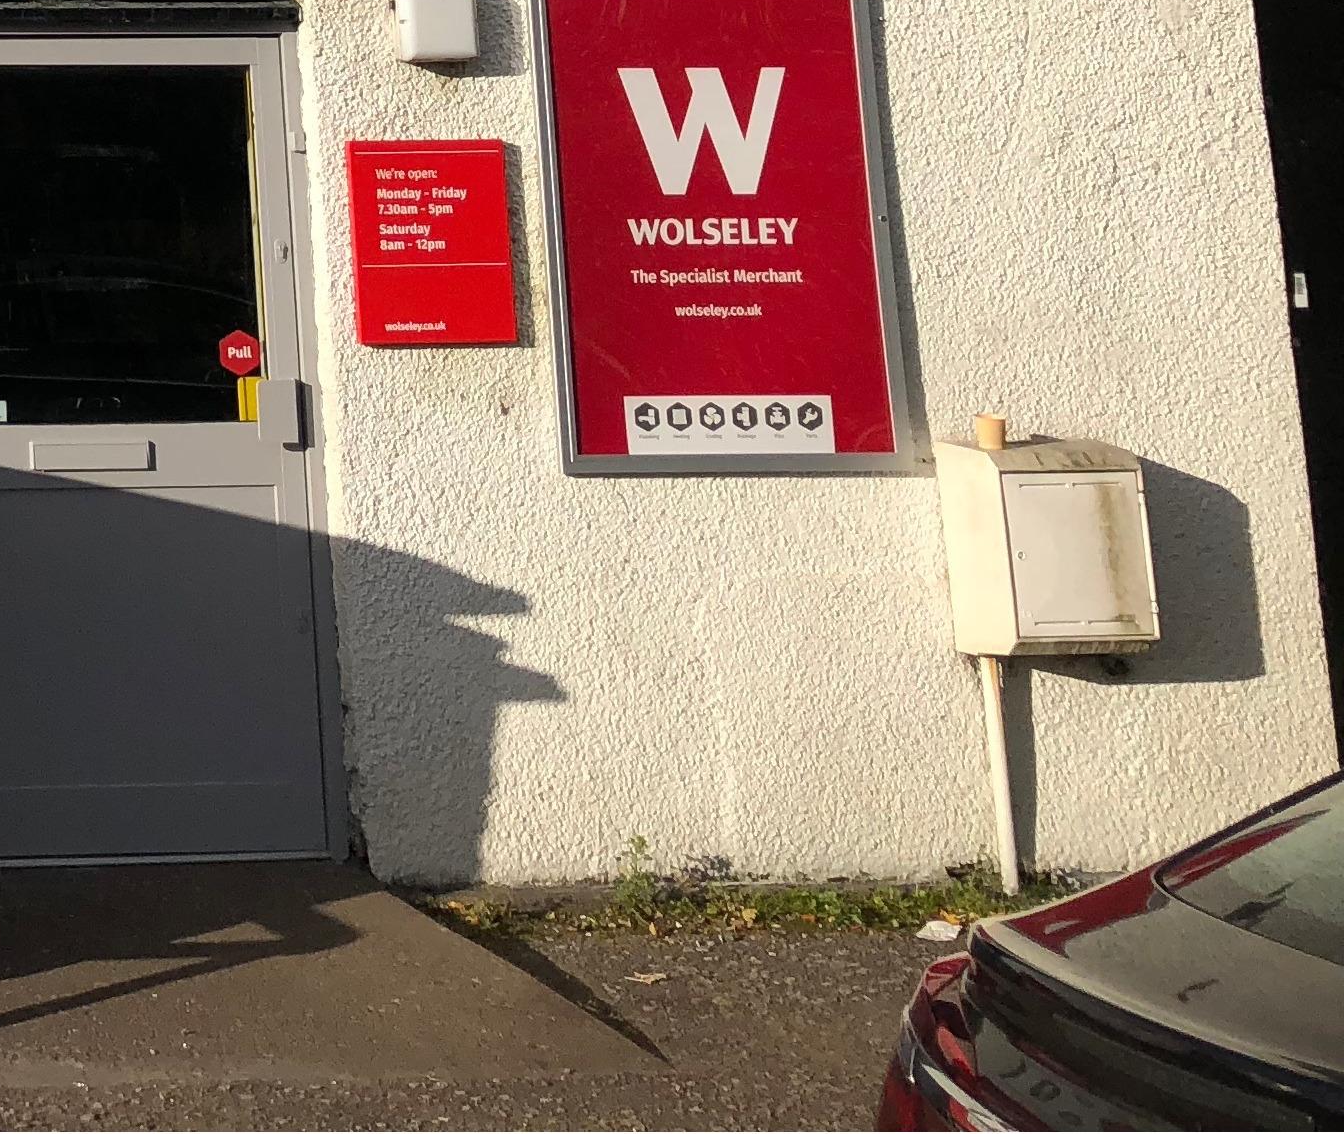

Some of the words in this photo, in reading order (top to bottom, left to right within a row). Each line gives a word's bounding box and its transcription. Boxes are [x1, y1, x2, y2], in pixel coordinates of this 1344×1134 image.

[616, 66, 787, 196] W
[374, 167, 406, 180] We're
[407, 169, 438, 182] open:
[376, 187, 422, 202] Monday
[431, 187, 468, 201] Friday
[377, 203, 419, 215] 7.30am
[427, 203, 454, 217] 5pm
[378, 223, 432, 237] Saturday
[626, 217, 799, 247] WOLSELEY
[379, 239, 406, 251] 8am
[415, 239, 446, 252] 12pm
[630, 268, 658, 284] The
[659, 267, 731, 287] Specialist
[733, 267, 804, 284] Merchant
[674, 303, 763, 319] wolseley.co.uk
[384, 320, 447, 333] wolseley.co.uk
[227, 345, 253, 359] Pull
